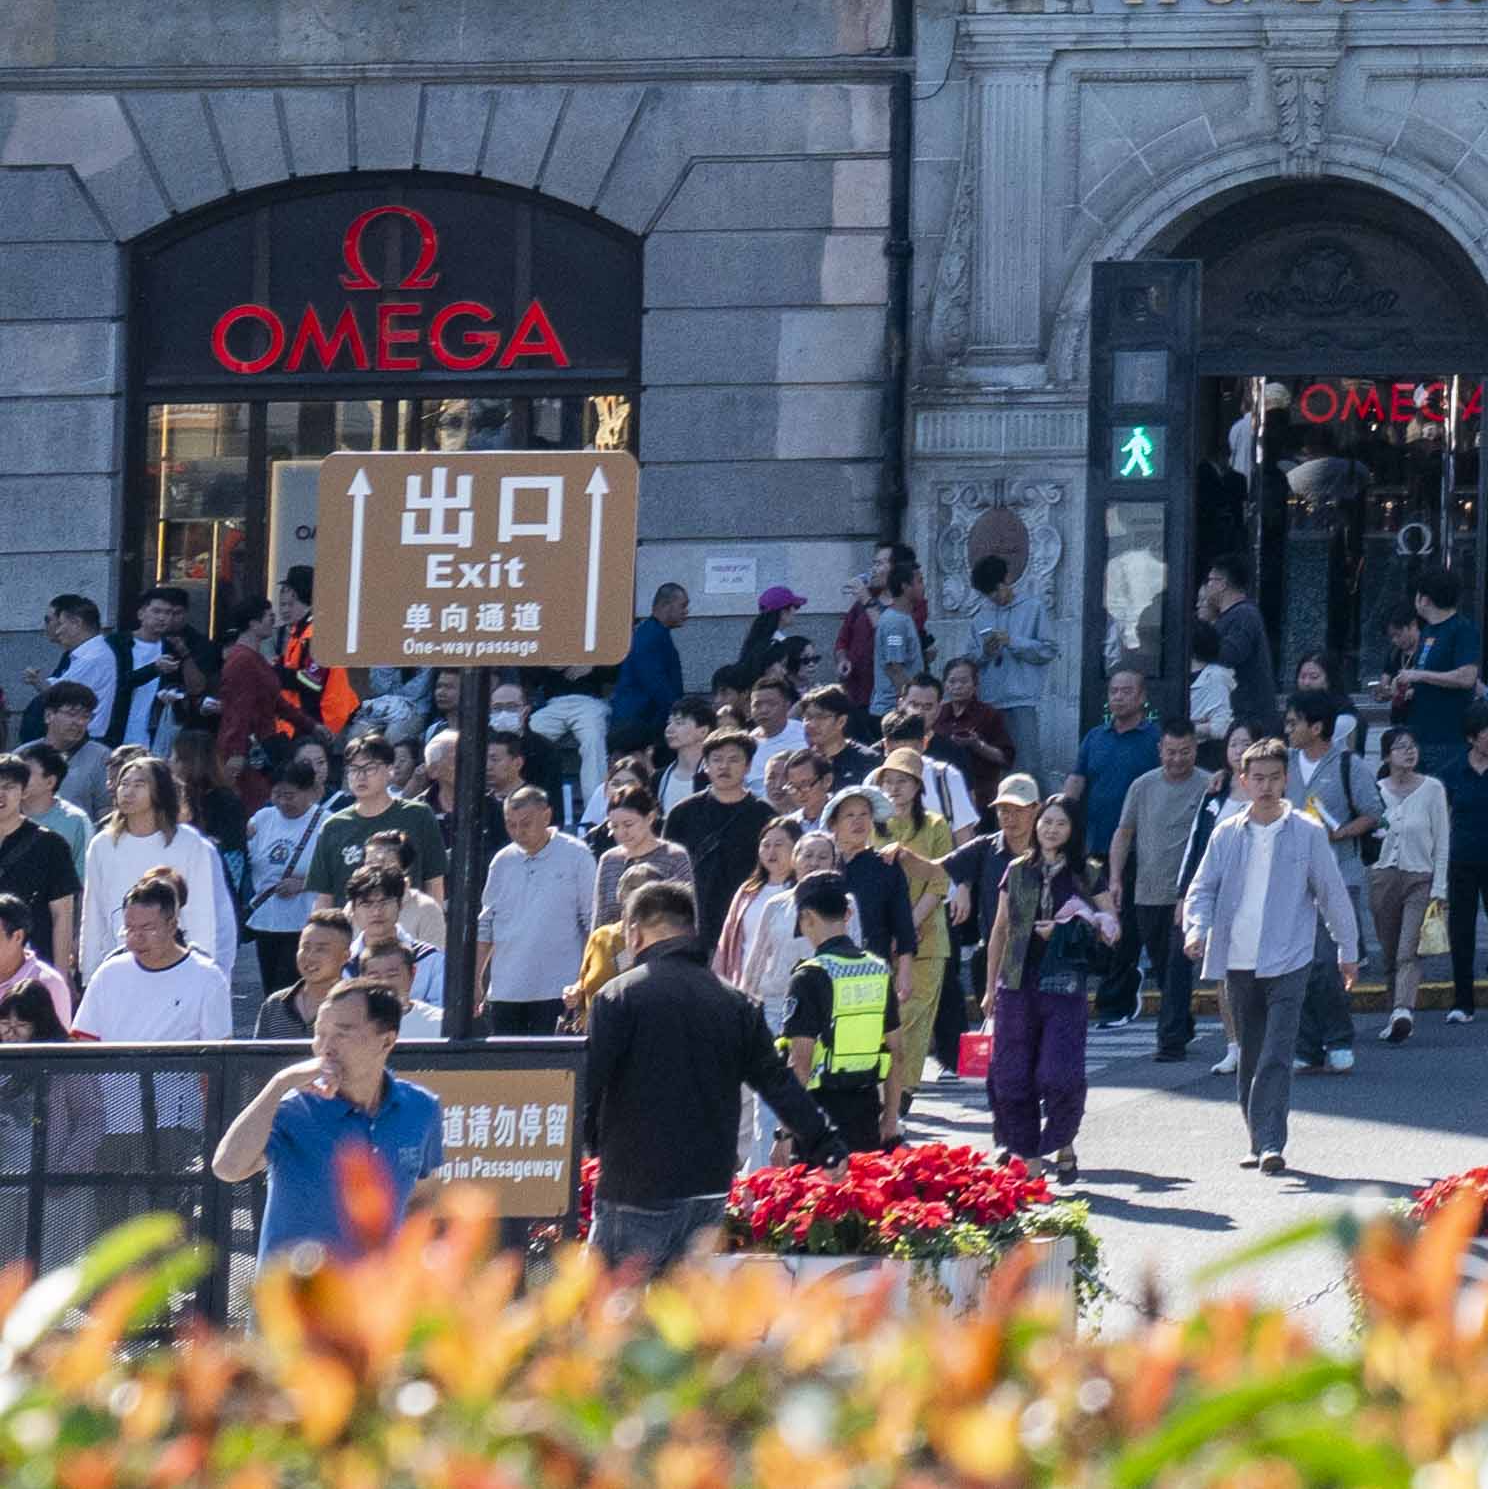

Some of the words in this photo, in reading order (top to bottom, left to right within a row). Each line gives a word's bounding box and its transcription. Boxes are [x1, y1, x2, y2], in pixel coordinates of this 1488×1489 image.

[211, 298, 569, 374] OMEGA
[400, 467, 565, 549] 出口
[426, 553, 527, 589] Exit
[402, 602, 543, 633] 单向通道
[403, 637, 475, 657] One-way
[476, 639, 538, 657] passage
[471, 1156, 564, 1183] Passageway
